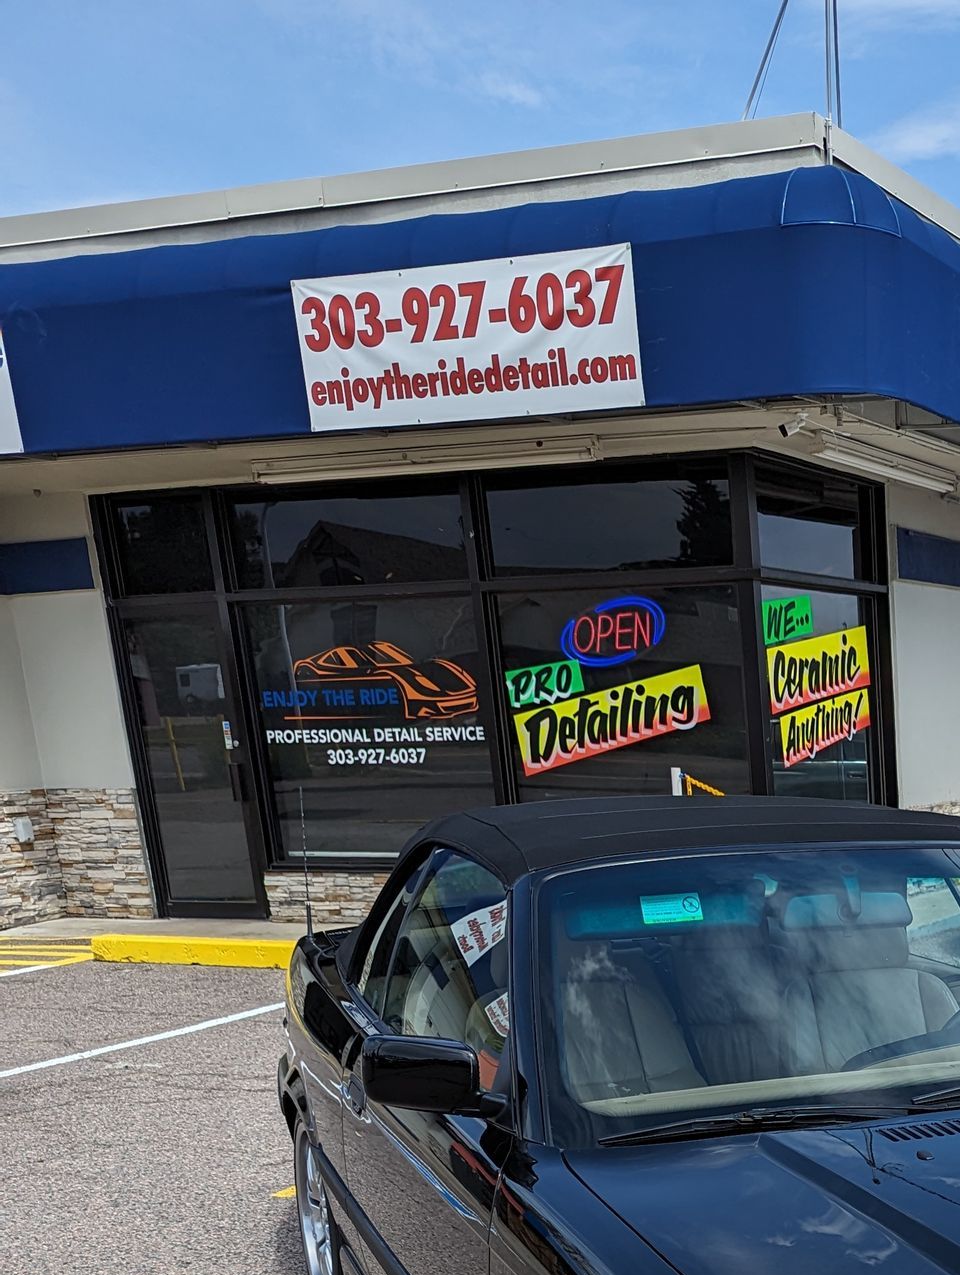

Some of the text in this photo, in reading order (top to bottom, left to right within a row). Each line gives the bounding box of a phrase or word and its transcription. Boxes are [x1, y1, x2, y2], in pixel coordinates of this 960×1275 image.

[301, 264, 625, 352] 303-927-6037
[311, 347, 637, 411] enjoytheridedetail.com
[574, 611, 650, 653] OPEN
[508, 664, 572, 707] PRO
[773, 633, 861, 708] Ceramic
[263, 688, 400, 708] ENJOY THE RIDE
[266, 726, 486, 744] PROFESSIONAL DETAIL SERVICE
[523, 684, 698, 768] Detailing
[785, 691, 864, 768] Anything!
[327, 748, 426, 765] 303-927-6037
